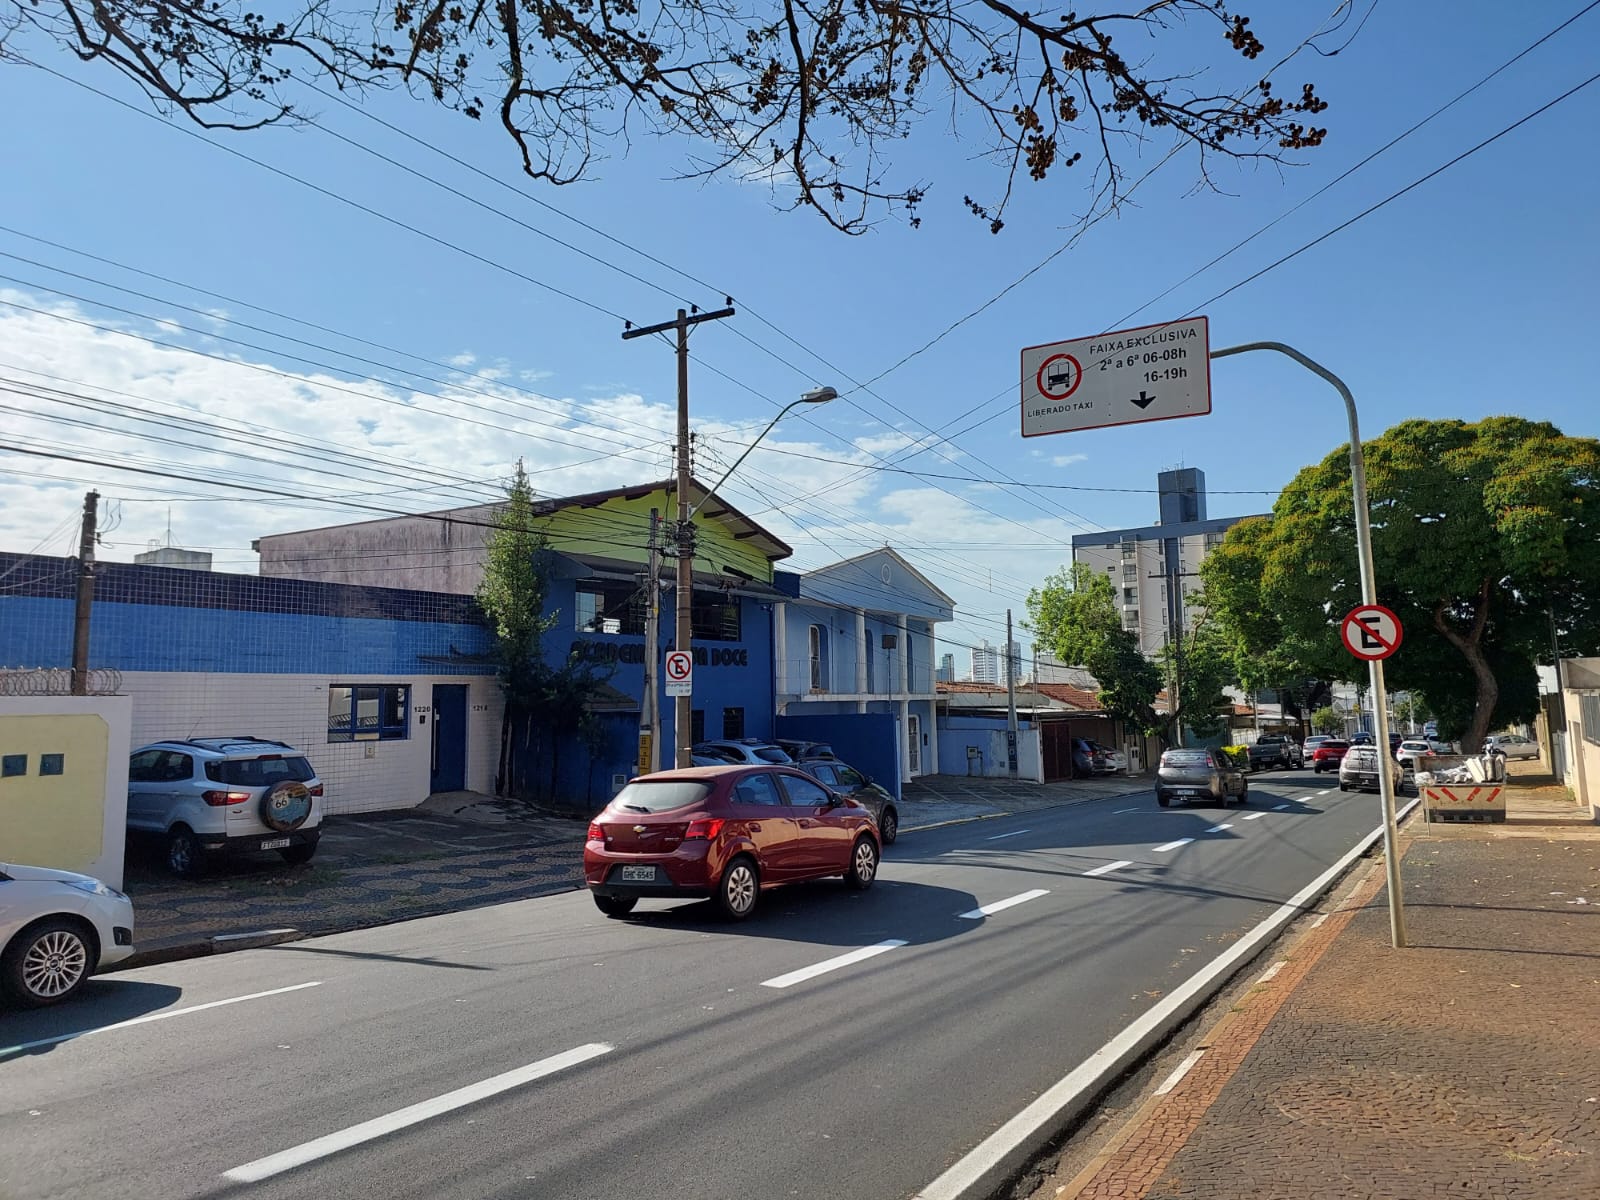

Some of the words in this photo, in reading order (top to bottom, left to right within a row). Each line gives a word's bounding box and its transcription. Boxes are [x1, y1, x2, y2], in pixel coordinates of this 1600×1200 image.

[1089, 341, 1124, 355] FAIXA
[1126, 328, 1197, 349] EXCLUSIVA
[1116, 359, 1123, 369] a
[1143, 347, 1187, 364] 06-08h
[1143, 367, 1188, 383] 16-19h
[1027, 405, 1071, 417] LIBERADO
[711, 648, 748, 667] DOCE
[414, 705, 431, 713] 1220
